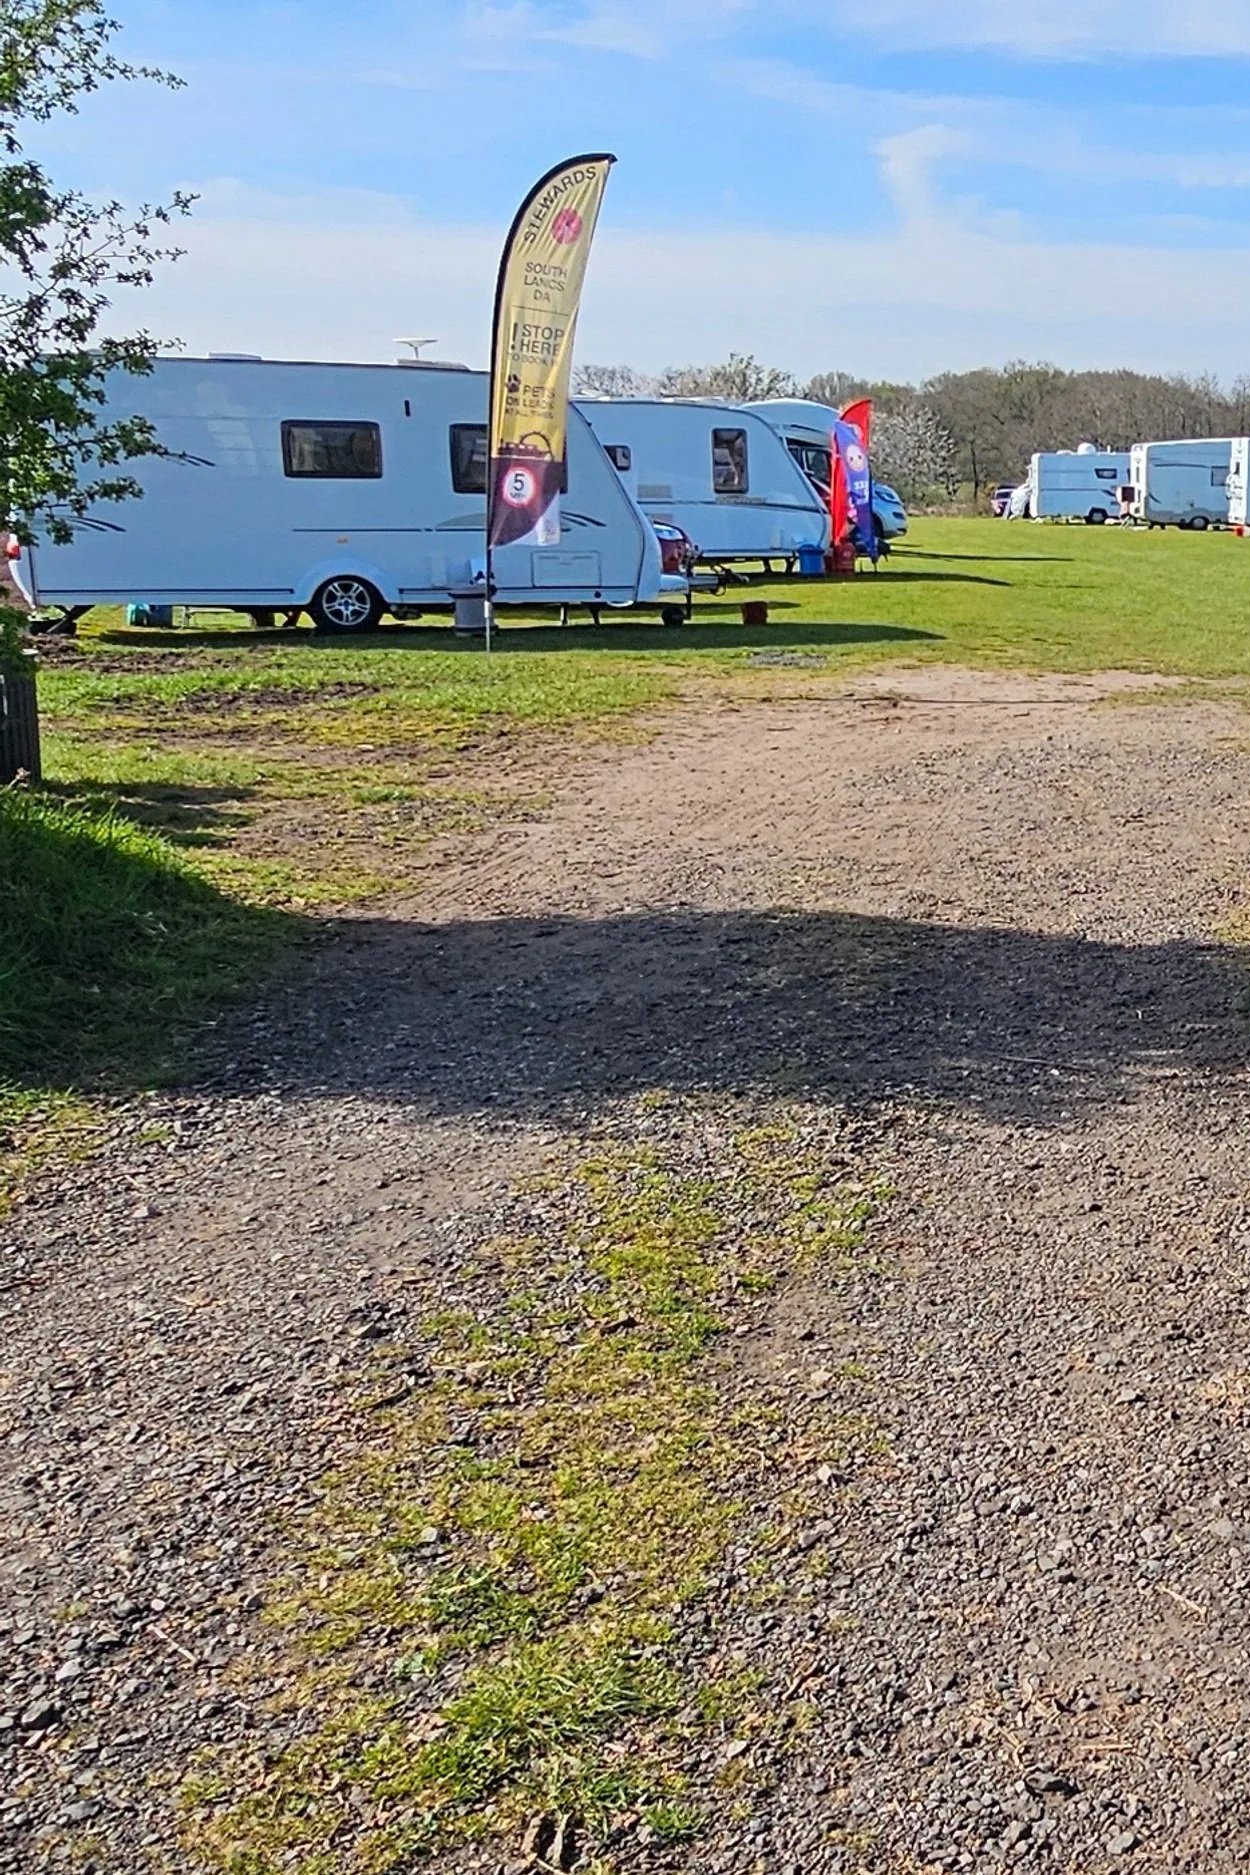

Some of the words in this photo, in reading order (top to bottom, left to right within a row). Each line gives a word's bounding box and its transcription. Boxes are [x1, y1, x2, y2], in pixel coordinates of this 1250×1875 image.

[524, 165, 597, 244] STEWARDS
[524, 261, 568, 279] SOUTH
[524, 274, 565, 292] LANCS
[533, 289, 551, 303] DA
[521, 323, 565, 341] STOP
[520, 338, 561, 356] HERE
[523, 384, 556, 399] PETS
[512, 472, 525, 492] 5
